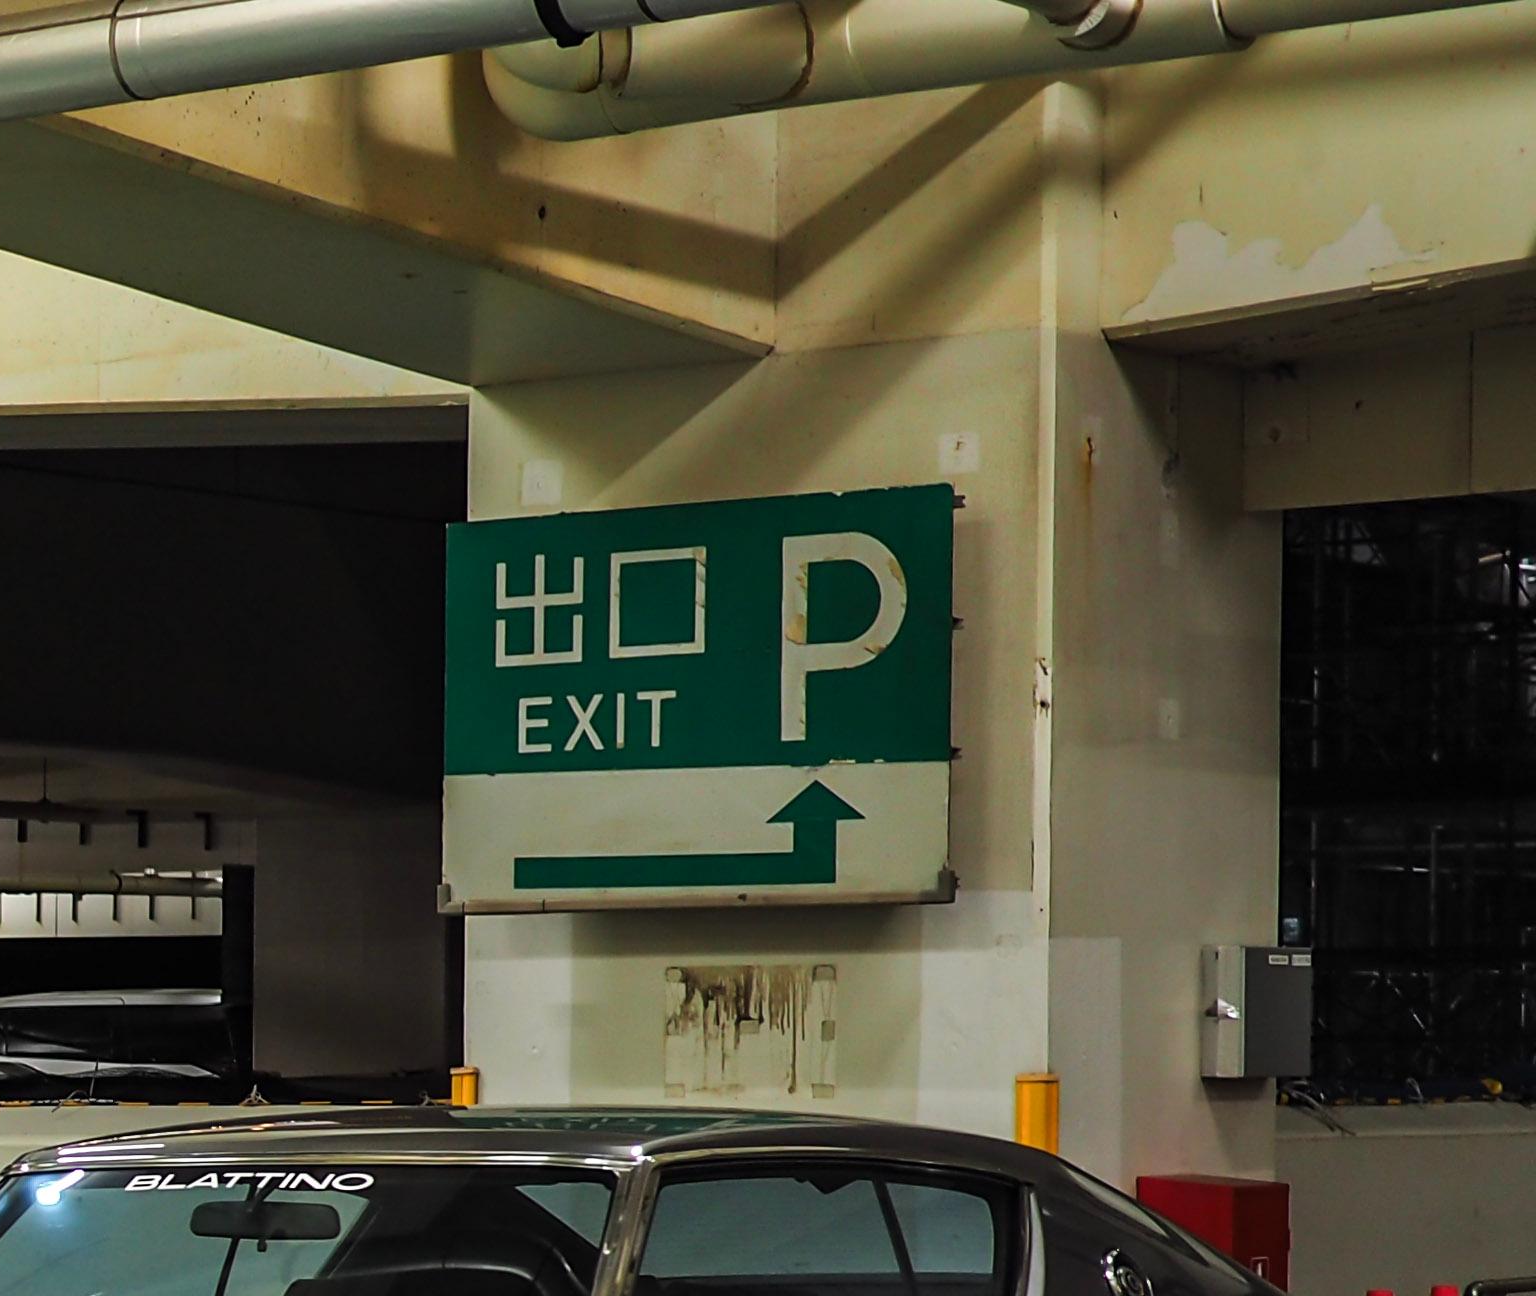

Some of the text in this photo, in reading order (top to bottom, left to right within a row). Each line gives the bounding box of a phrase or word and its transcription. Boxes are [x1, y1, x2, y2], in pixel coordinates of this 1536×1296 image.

[495, 546, 707, 668] 出口
[780, 531, 908, 742] P
[517, 690, 677, 754] EXIT
[124, 1172, 375, 1192] BLATTINO
